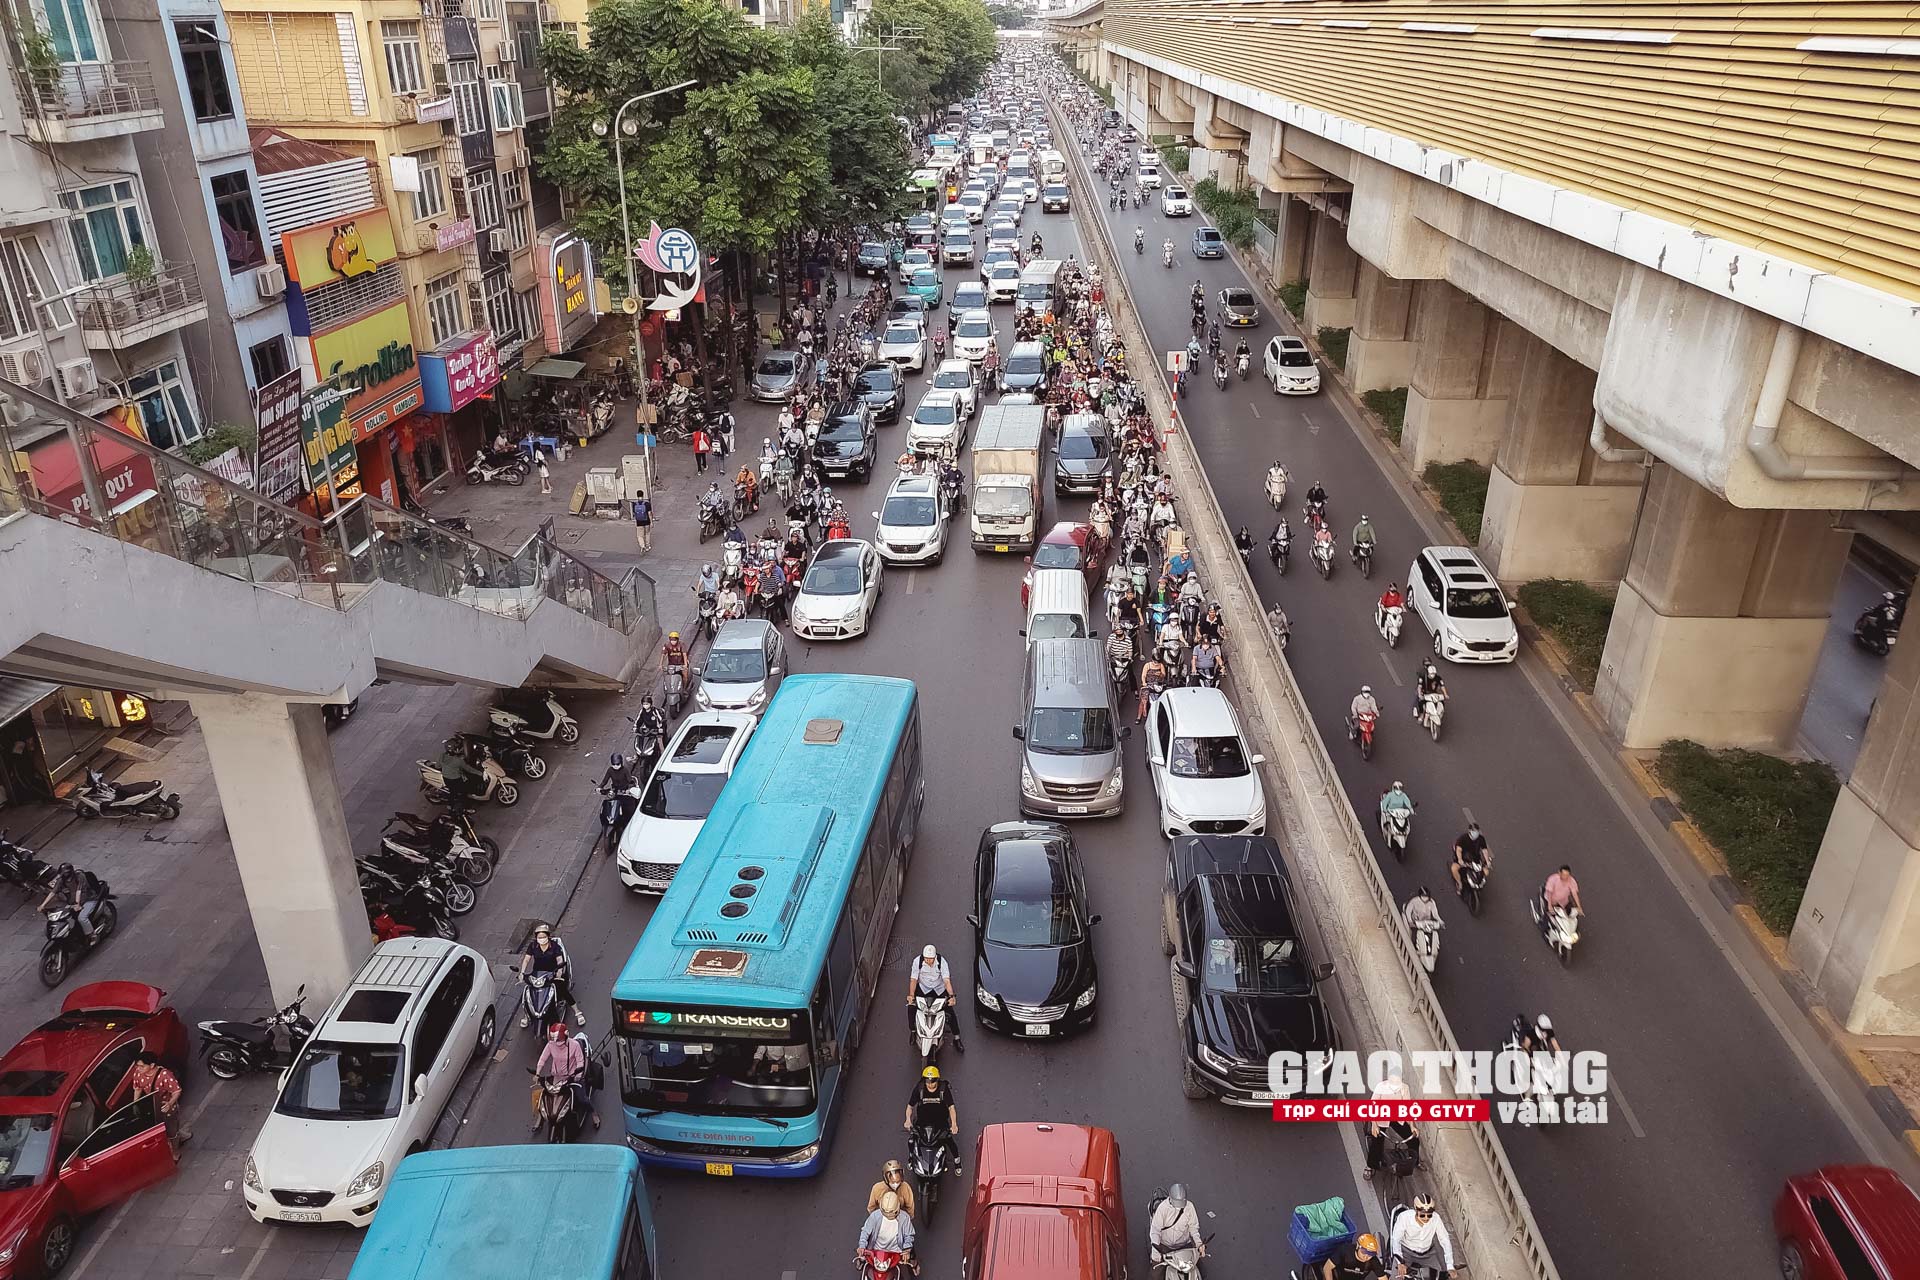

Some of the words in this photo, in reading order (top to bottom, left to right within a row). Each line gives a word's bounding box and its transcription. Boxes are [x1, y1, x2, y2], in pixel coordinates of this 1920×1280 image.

[566, 289, 585, 313] HANNA
[301, 402, 312, 421] JP
[105, 465, 134, 499] QUÝ
[1811, 907, 1825, 924] F7
[677, 1012, 788, 1028] TRANSERCO
